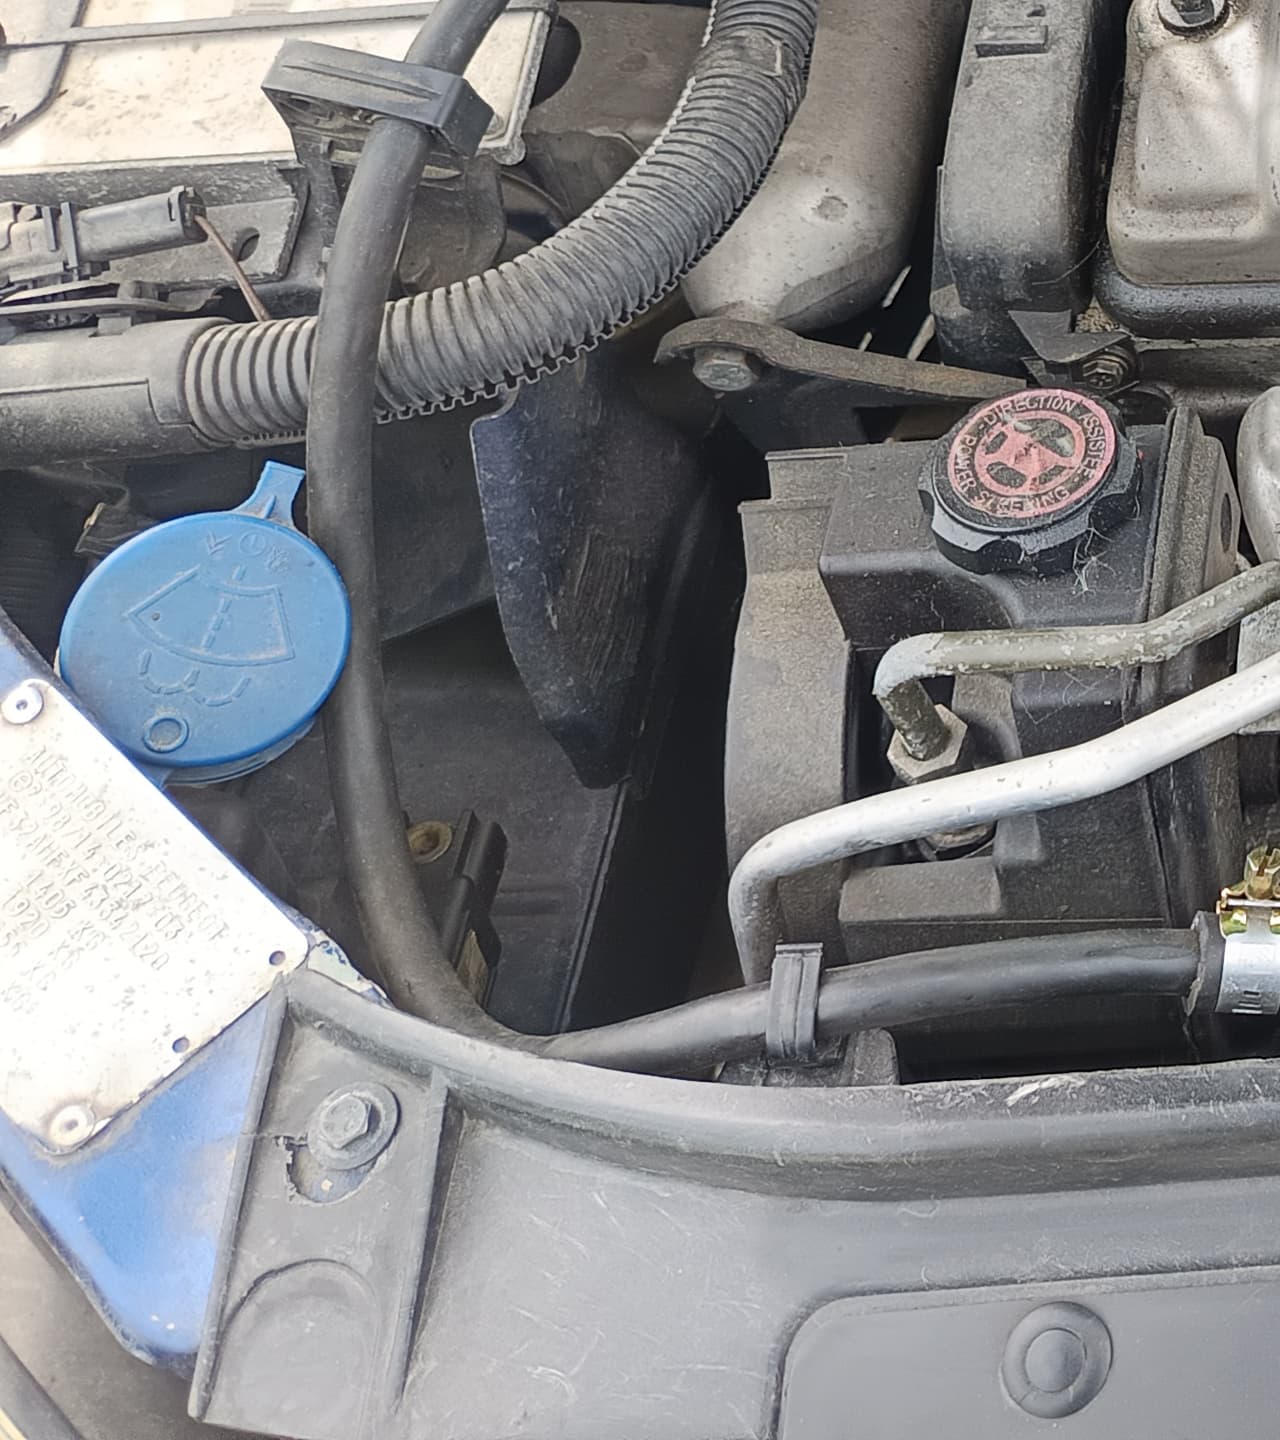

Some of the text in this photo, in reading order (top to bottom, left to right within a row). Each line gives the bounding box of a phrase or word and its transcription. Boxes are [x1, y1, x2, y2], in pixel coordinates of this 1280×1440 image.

[983, 396, 1076, 425] DIRECTION
[955, 435, 977, 492] POWER
[143, 858, 230, 946] PEUGEOT
